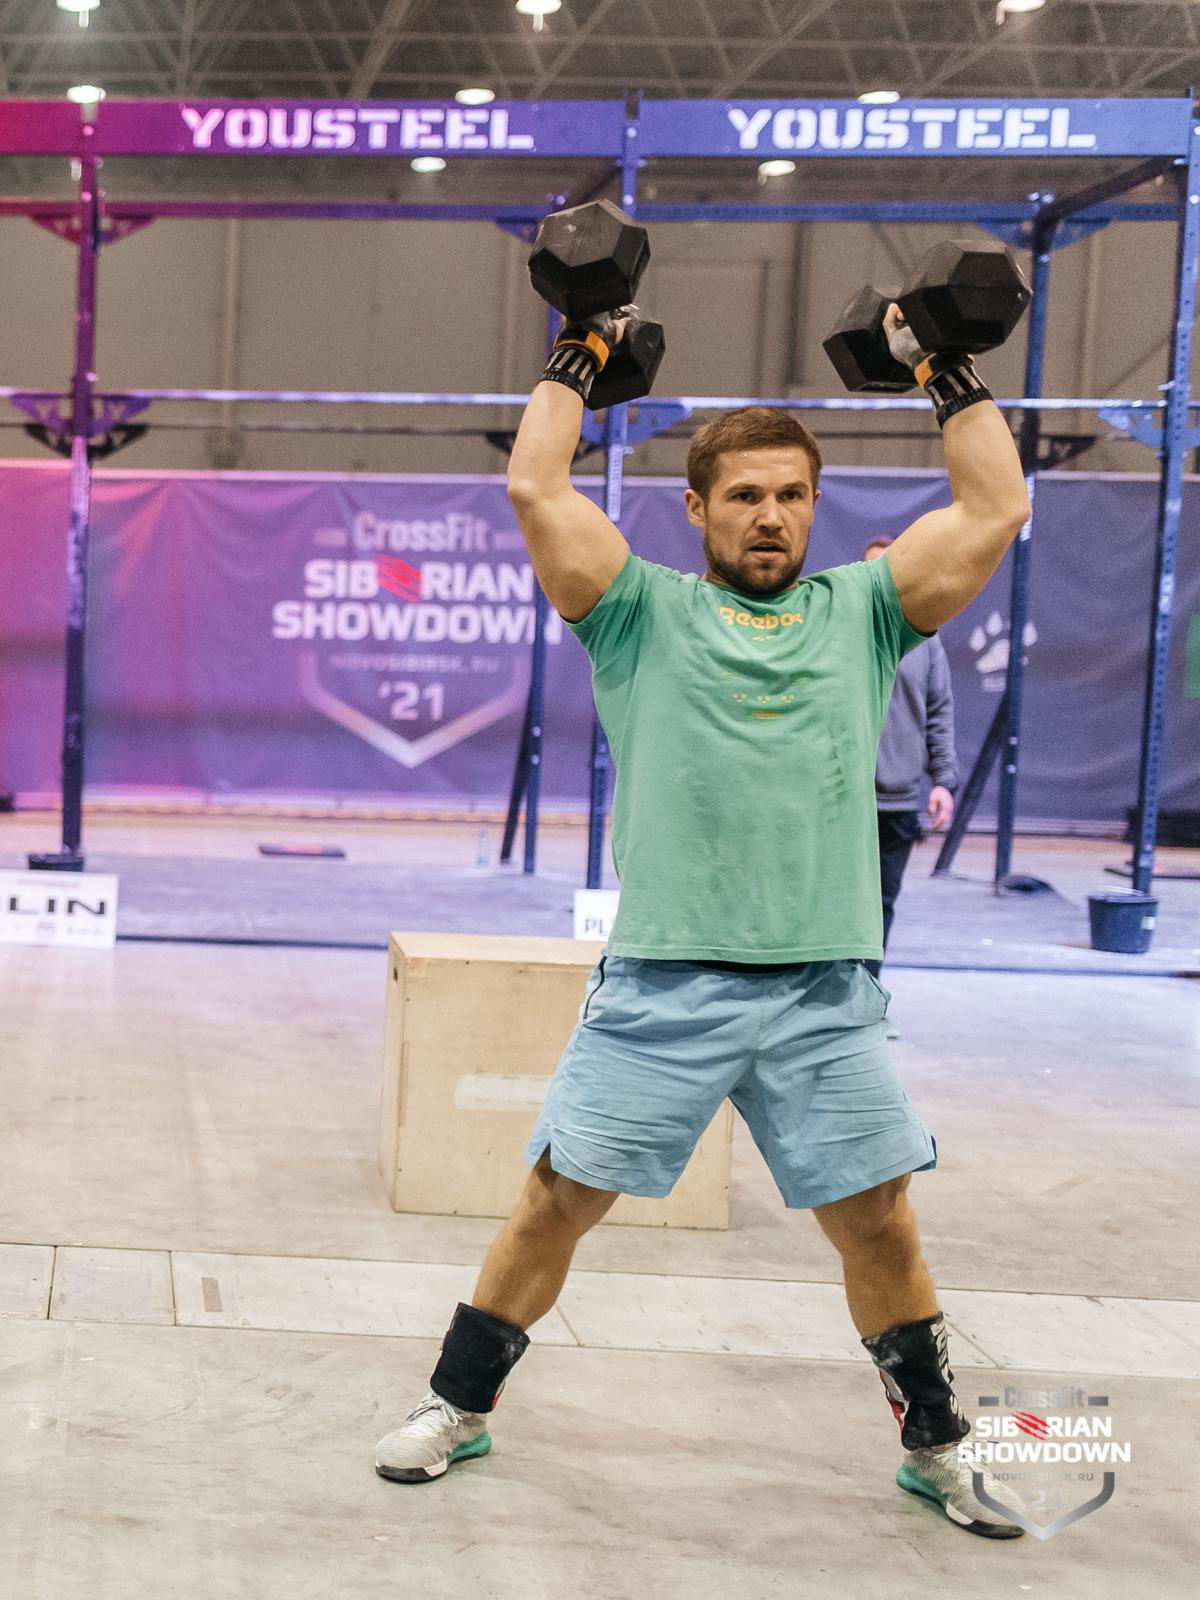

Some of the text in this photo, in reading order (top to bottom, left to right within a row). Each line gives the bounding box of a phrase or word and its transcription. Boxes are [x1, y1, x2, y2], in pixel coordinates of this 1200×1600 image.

[181, 108, 535, 149] YOUSTEEL
[727, 108, 1096, 150] YOUSTEEL
[354, 511, 490, 551] CrossFit
[304, 558, 535, 602] SIBRIAN
[272, 600, 562, 645] SHOWDOWN
